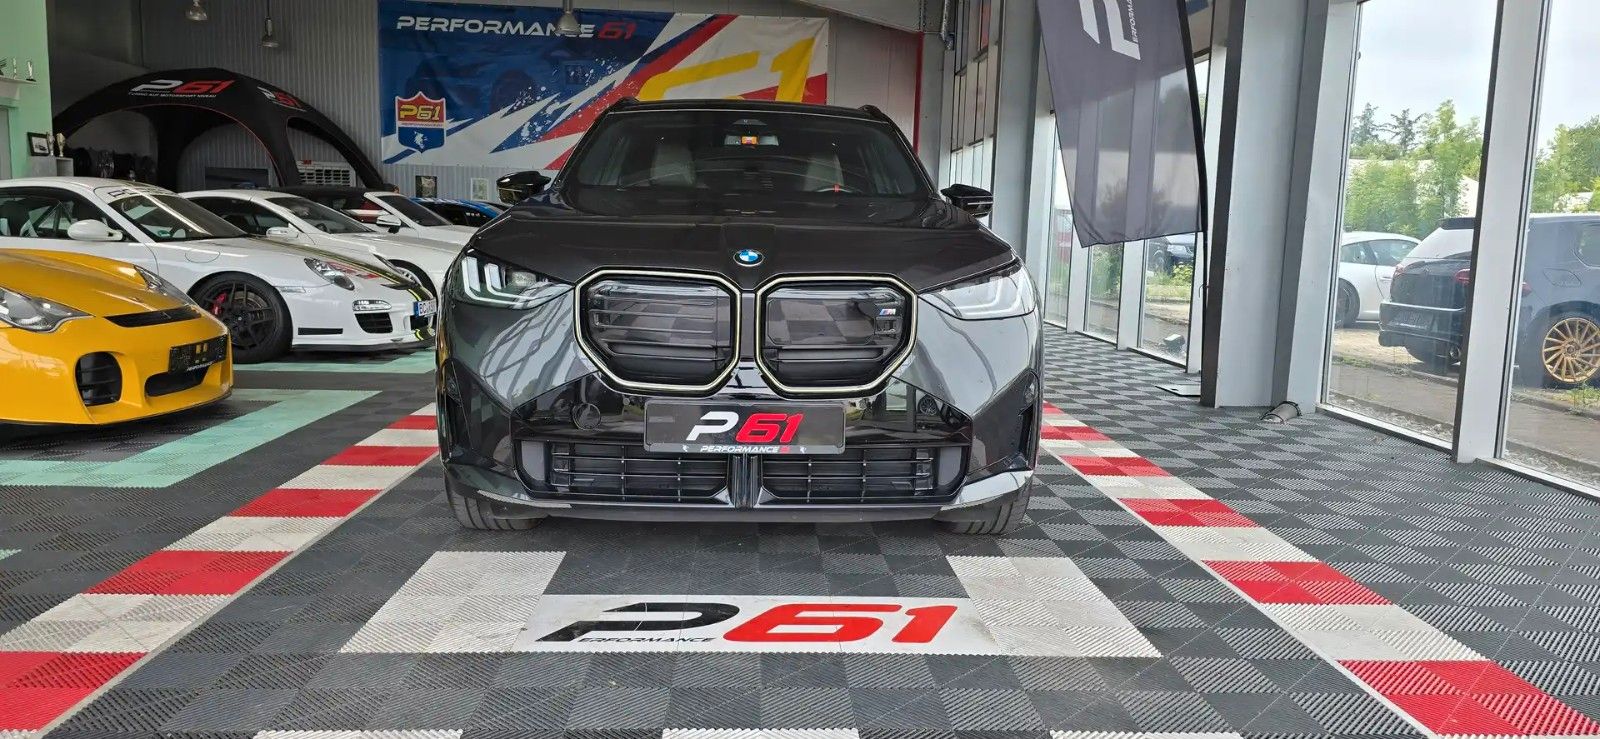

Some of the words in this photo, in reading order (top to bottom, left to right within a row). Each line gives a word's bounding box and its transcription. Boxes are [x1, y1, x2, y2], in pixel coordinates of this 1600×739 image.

[396, 16, 595, 38] PERFORMANE
[598, 21, 637, 41] 61
[131, 79, 236, 94] P61
[400, 104, 441, 120] P61
[685, 410, 805, 444] P61
[700, 445, 779, 453] PERFORMANCE
[535, 602, 959, 644] P61
